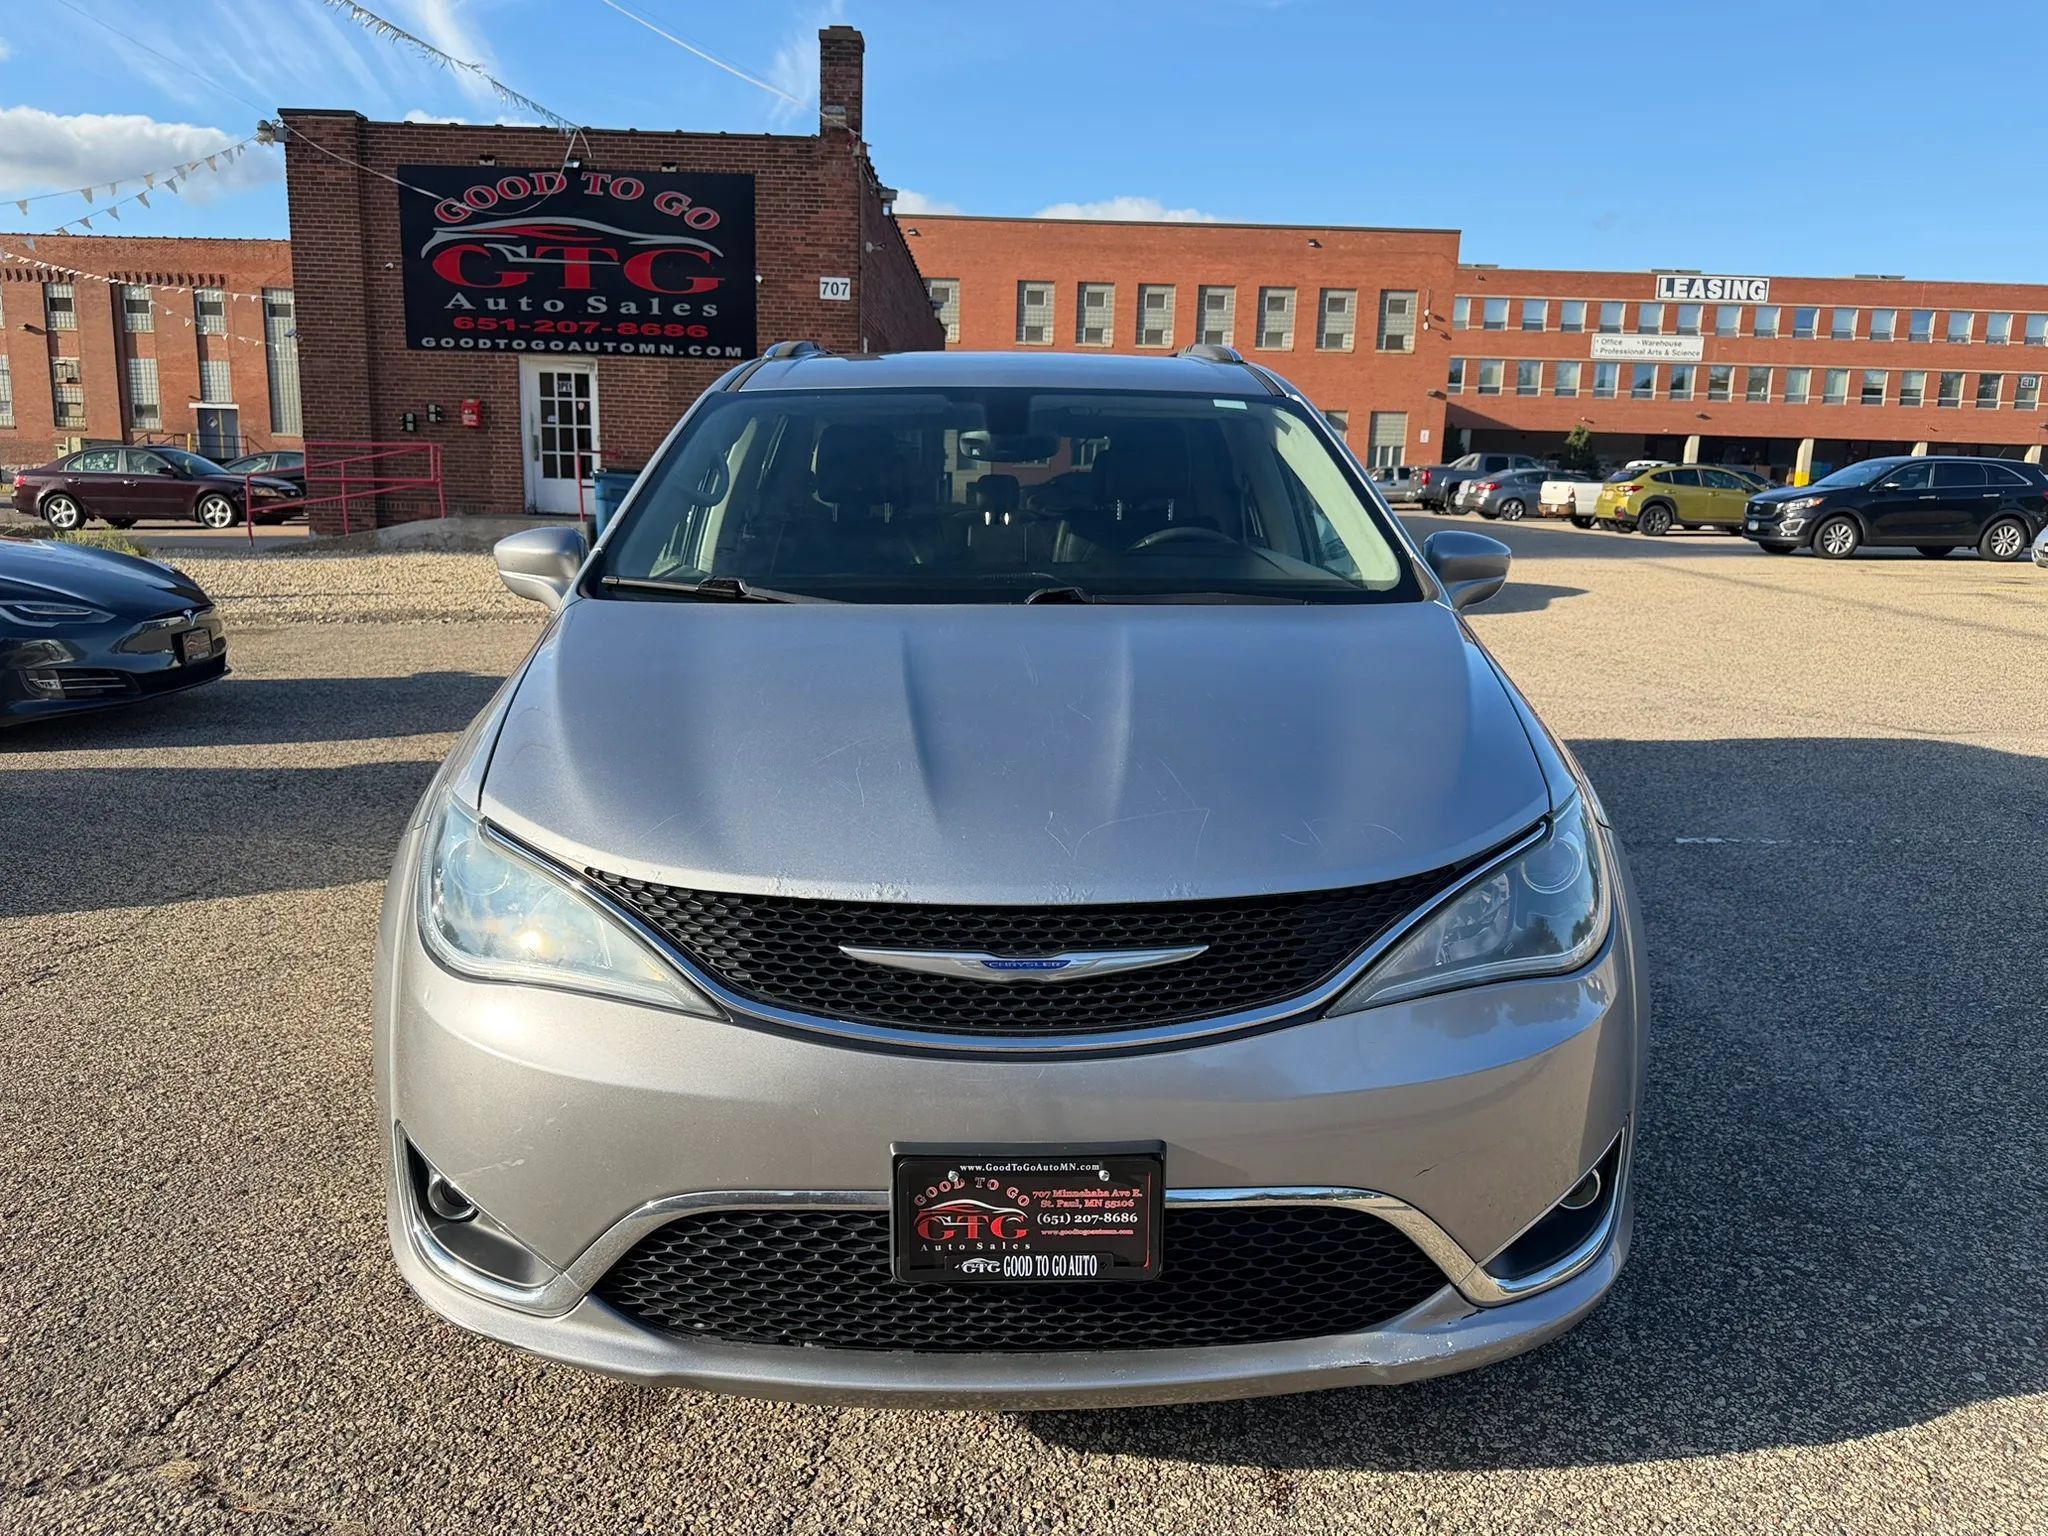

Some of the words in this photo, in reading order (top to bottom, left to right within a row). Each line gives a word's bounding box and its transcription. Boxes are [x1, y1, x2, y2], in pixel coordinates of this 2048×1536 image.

[434, 171, 568, 224] GOOD
[581, 172, 645, 201] TO
[653, 190, 721, 231] GO
[432, 244, 726, 295] GTG
[821, 281, 849, 296] 707
[1659, 278, 1766, 301] LEASING
[444, 292, 565, 313] Auto
[587, 295, 719, 317] Sales
[453, 315, 710, 338] 651-207-8686
[421, 336, 743, 358] GOODTOGOAUTOMN.COM
[1600, 346, 1645, 355] Professional
[1601, 336, 1623, 345] Office
[1642, 338, 1682, 347] Warehouse
[960, 1162, 1100, 1172] www.GoodToGoAutoMN.com
[914, 1178, 966, 1206] GOOD
[974, 1177, 1000, 1191] TO
[1006, 1186, 1030, 1207] GO
[1032, 1190, 1051, 1199] 707
[1111, 1188, 1131, 1198] Ave
[1041, 1199, 1055, 1208] St.
[1056, 1199, 1083, 1209] Paul,
[1084, 1199, 1104, 1208] MN
[1104, 1199, 1135, 1209] 55106
[917, 1214, 1030, 1241] GTG
[1036, 1212, 1071, 1225] (651)
[1074, 1212, 1138, 1225] 207-8686
[920, 1242, 966, 1252] Auto
[976, 1241, 1031, 1251] Sales
[1003, 1255, 1033, 1277] GOOD
[1035, 1255, 1049, 1277] TO
[1051, 1255, 1067, 1277] GO
[1067, 1254, 1098, 1277] AUTO
